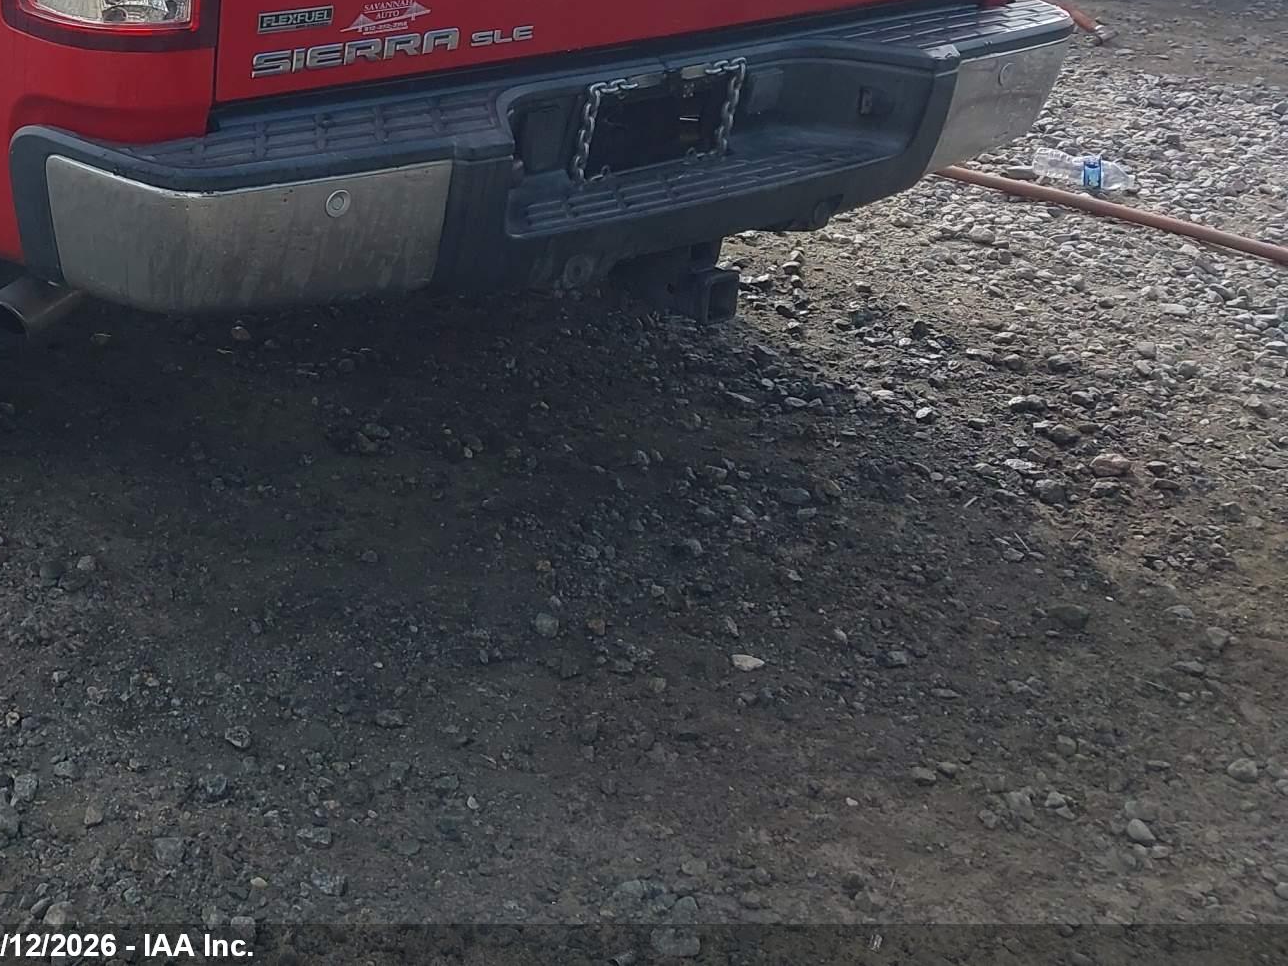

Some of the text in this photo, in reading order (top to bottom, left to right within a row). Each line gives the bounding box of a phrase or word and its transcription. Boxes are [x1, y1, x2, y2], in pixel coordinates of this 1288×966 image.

[263, 10, 330, 27] FLEXFUEL
[376, 10, 400, 20] AUTO
[251, 25, 534, 78] SIERRA SLE
